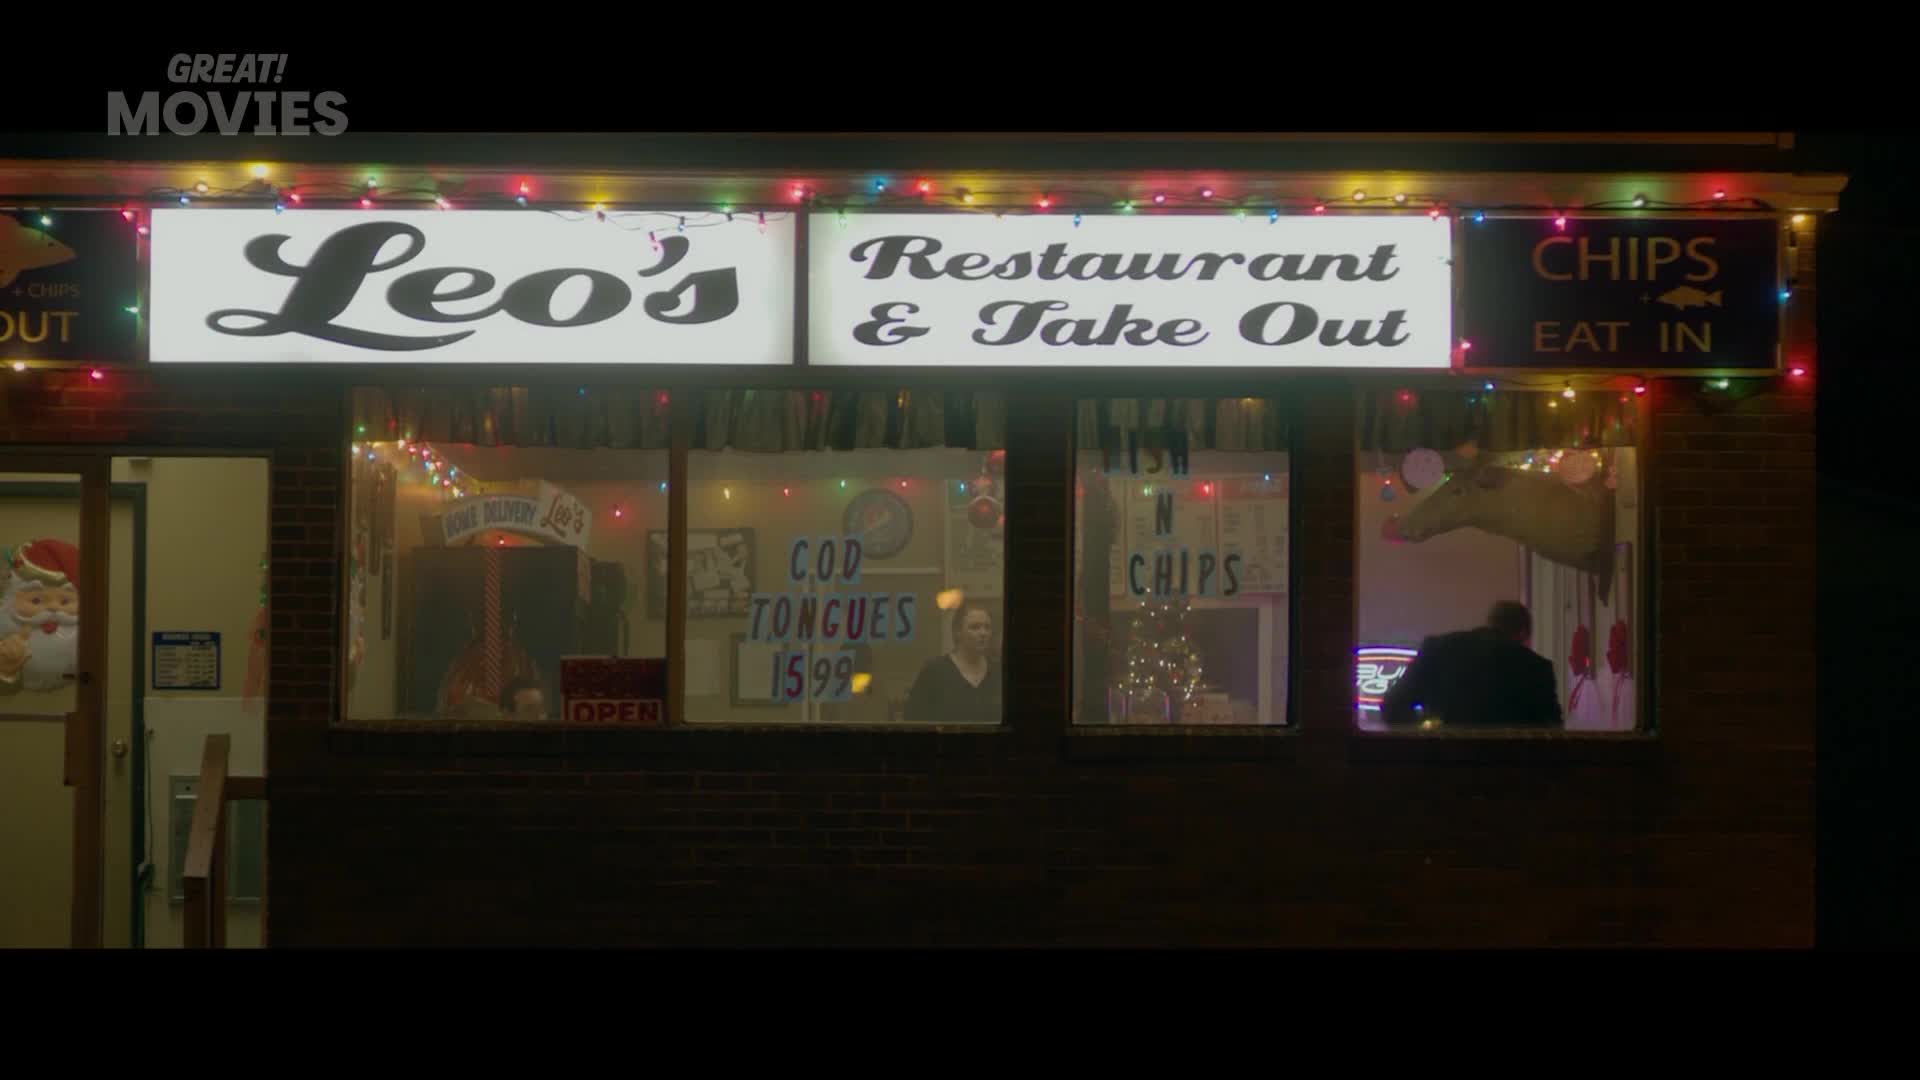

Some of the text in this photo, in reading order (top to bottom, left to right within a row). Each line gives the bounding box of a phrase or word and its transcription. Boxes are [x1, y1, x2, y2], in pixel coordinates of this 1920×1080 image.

[849, 236, 1400, 282] Restaurant
[1532, 236, 1719, 282] CHIPS
[206, 222, 740, 352] Leo's
[853, 301, 1410, 347] & Take Out
[1533, 321, 1711, 352] EAT IN
[1155, 493, 1174, 535] N
[791, 539, 862, 580] COD
[1129, 553, 1241, 596] CHIPS
[752, 597, 914, 640] TONGUES
[573, 702, 658, 721] OPEN
